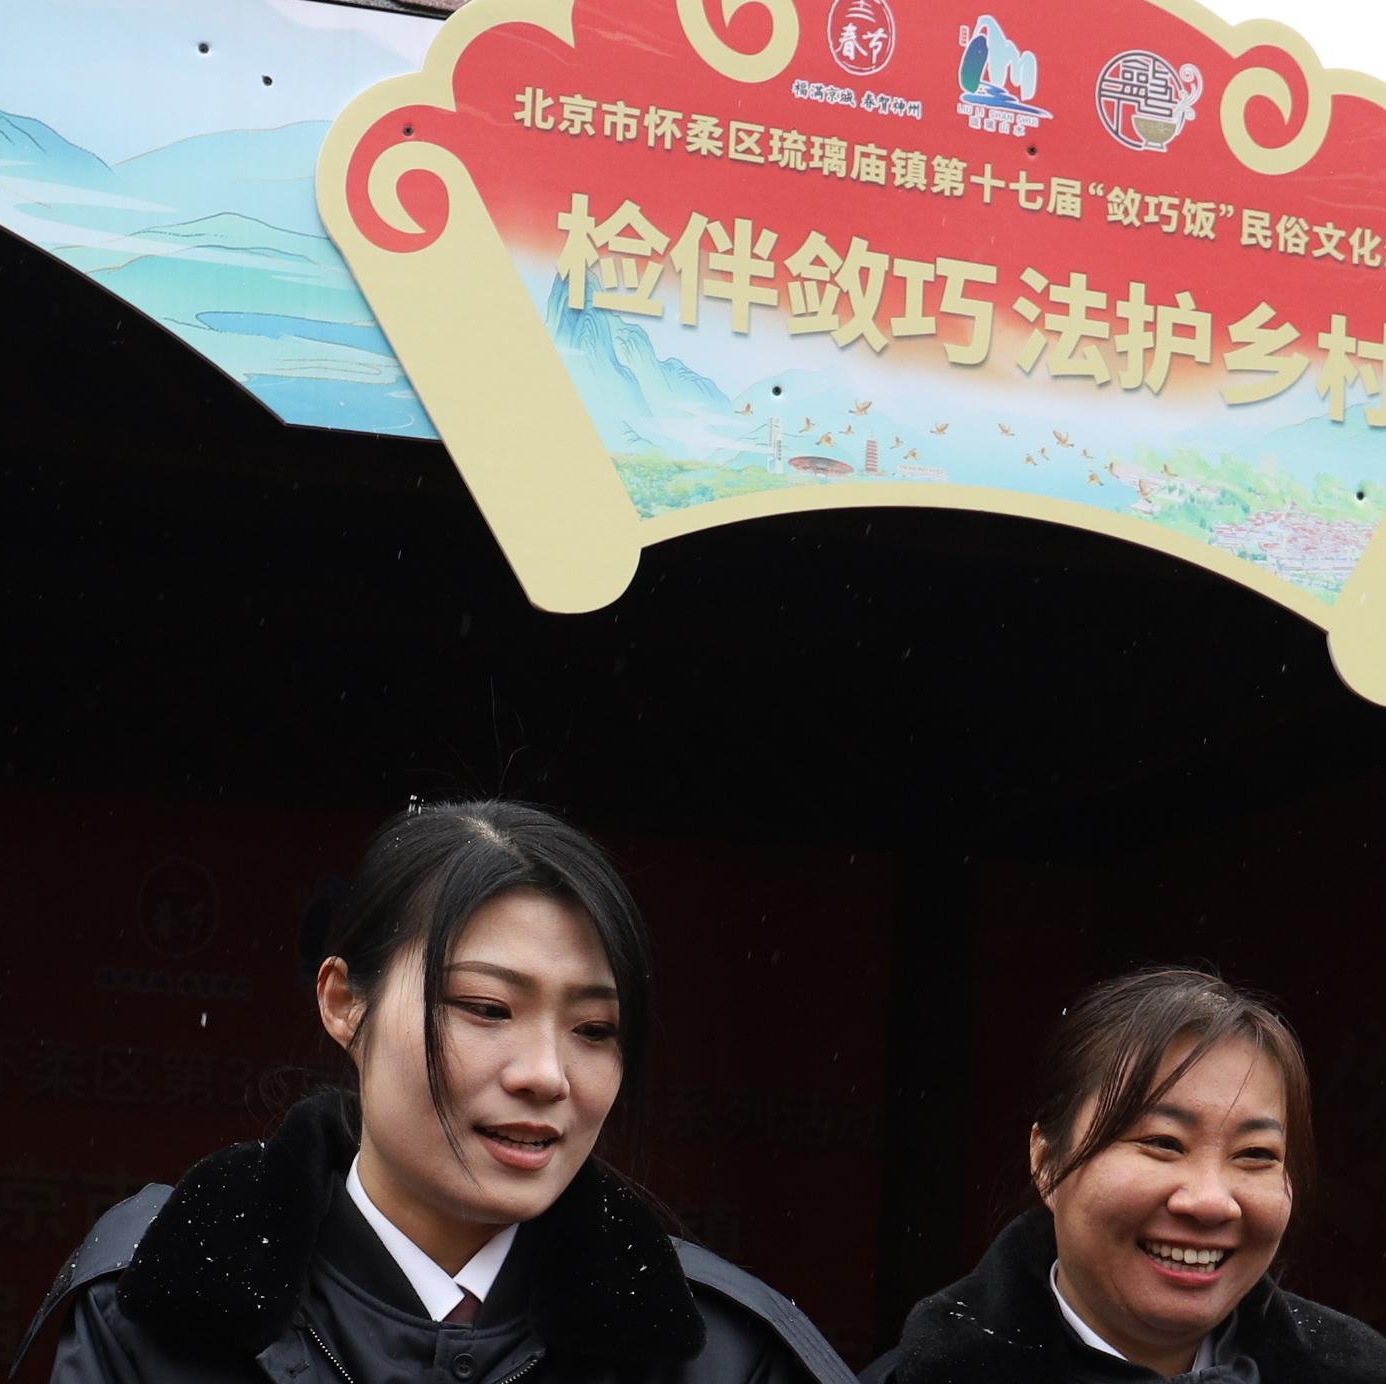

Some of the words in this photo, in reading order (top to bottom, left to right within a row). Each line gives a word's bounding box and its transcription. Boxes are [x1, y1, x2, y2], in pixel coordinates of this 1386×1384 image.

[835, 22, 888, 64] 春节
[555, 191, 998, 370] 检伴敛巧
